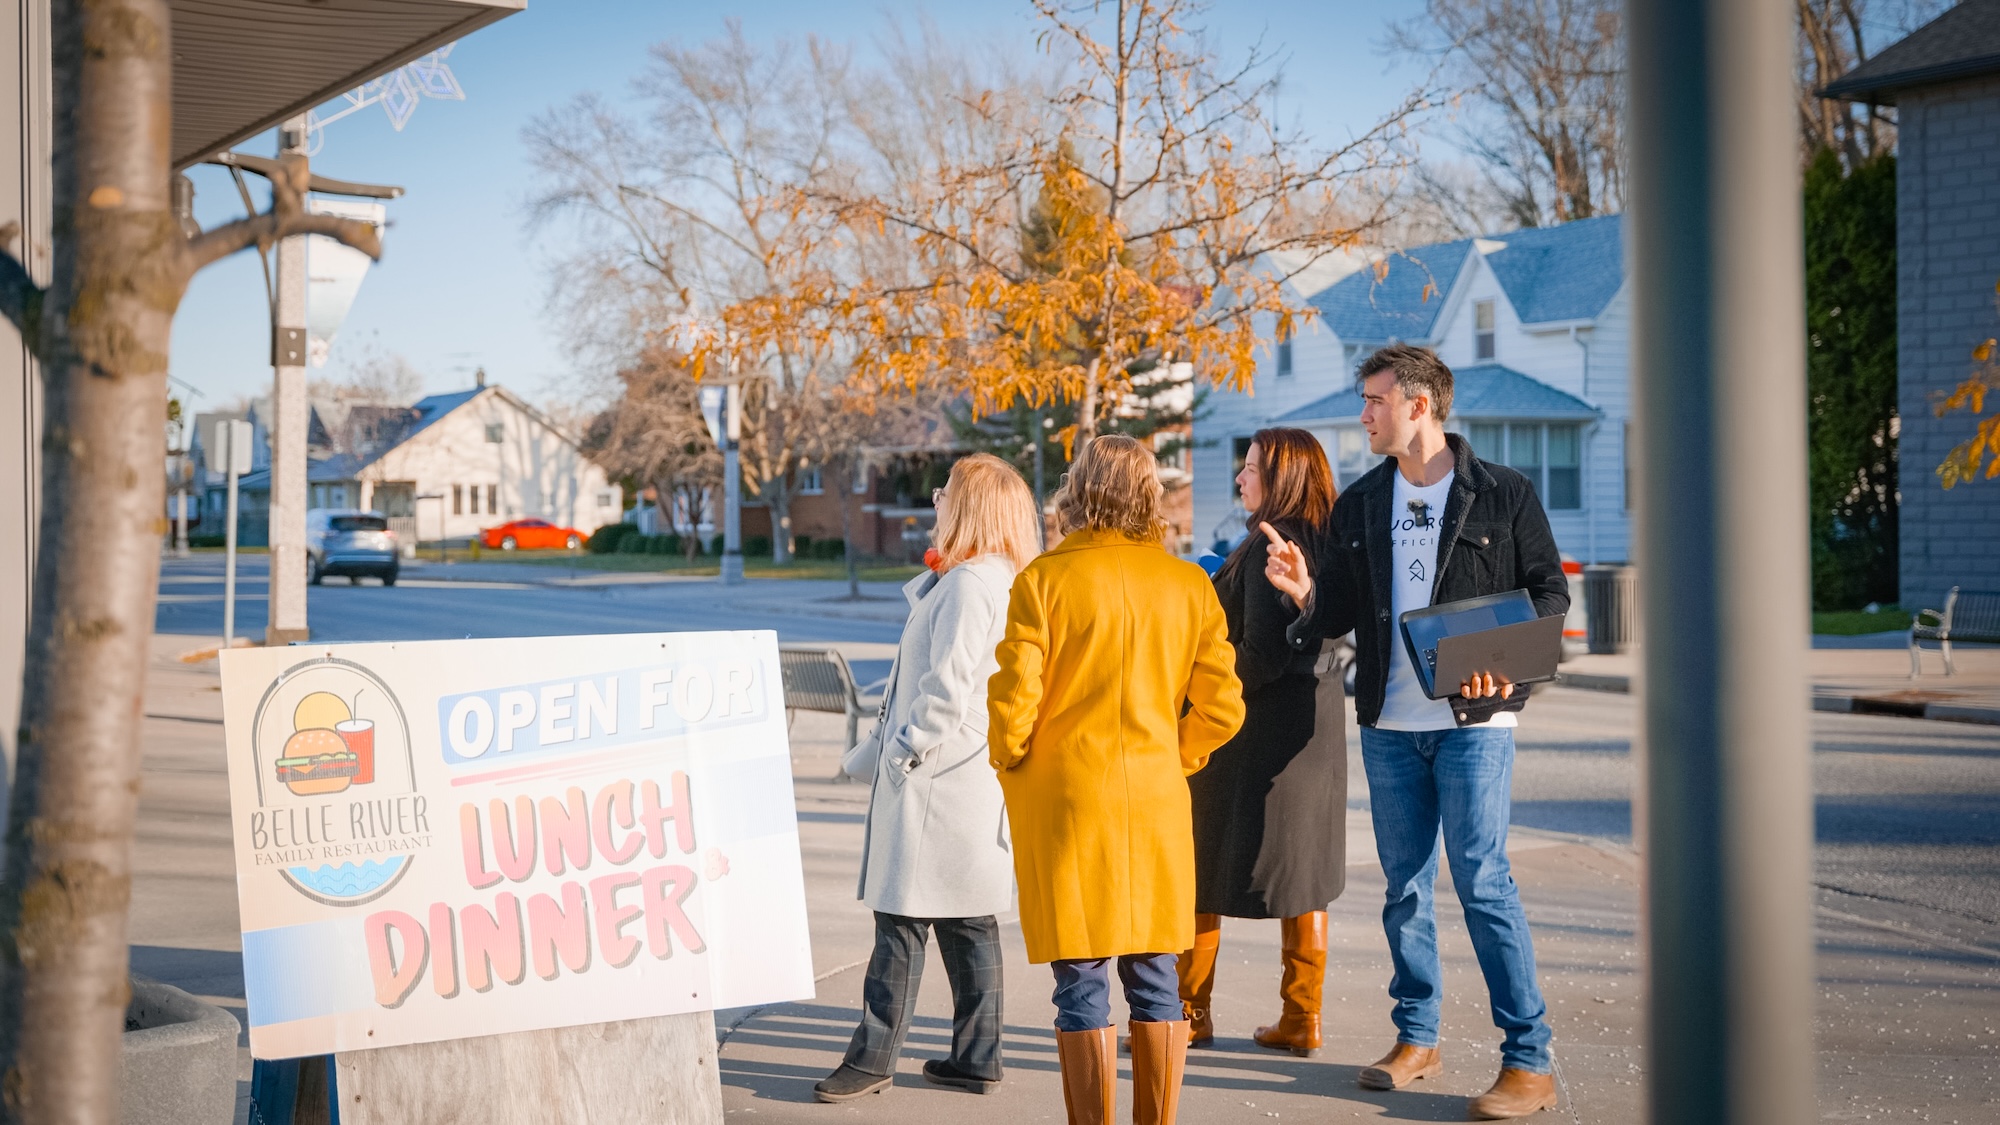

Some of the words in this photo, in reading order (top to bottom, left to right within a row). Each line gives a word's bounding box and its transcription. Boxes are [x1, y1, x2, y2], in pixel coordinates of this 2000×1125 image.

[447, 675, 620, 759] OPEN
[638, 659, 755, 731] FOR
[251, 804, 337, 850] BELLE
[350, 795, 430, 840] RIVER
[254, 849, 317, 866] FAMILY
[323, 835, 433, 859] RESTAURANT
[459, 770, 697, 890] LUNCH
[364, 864, 707, 1009] DINNER
